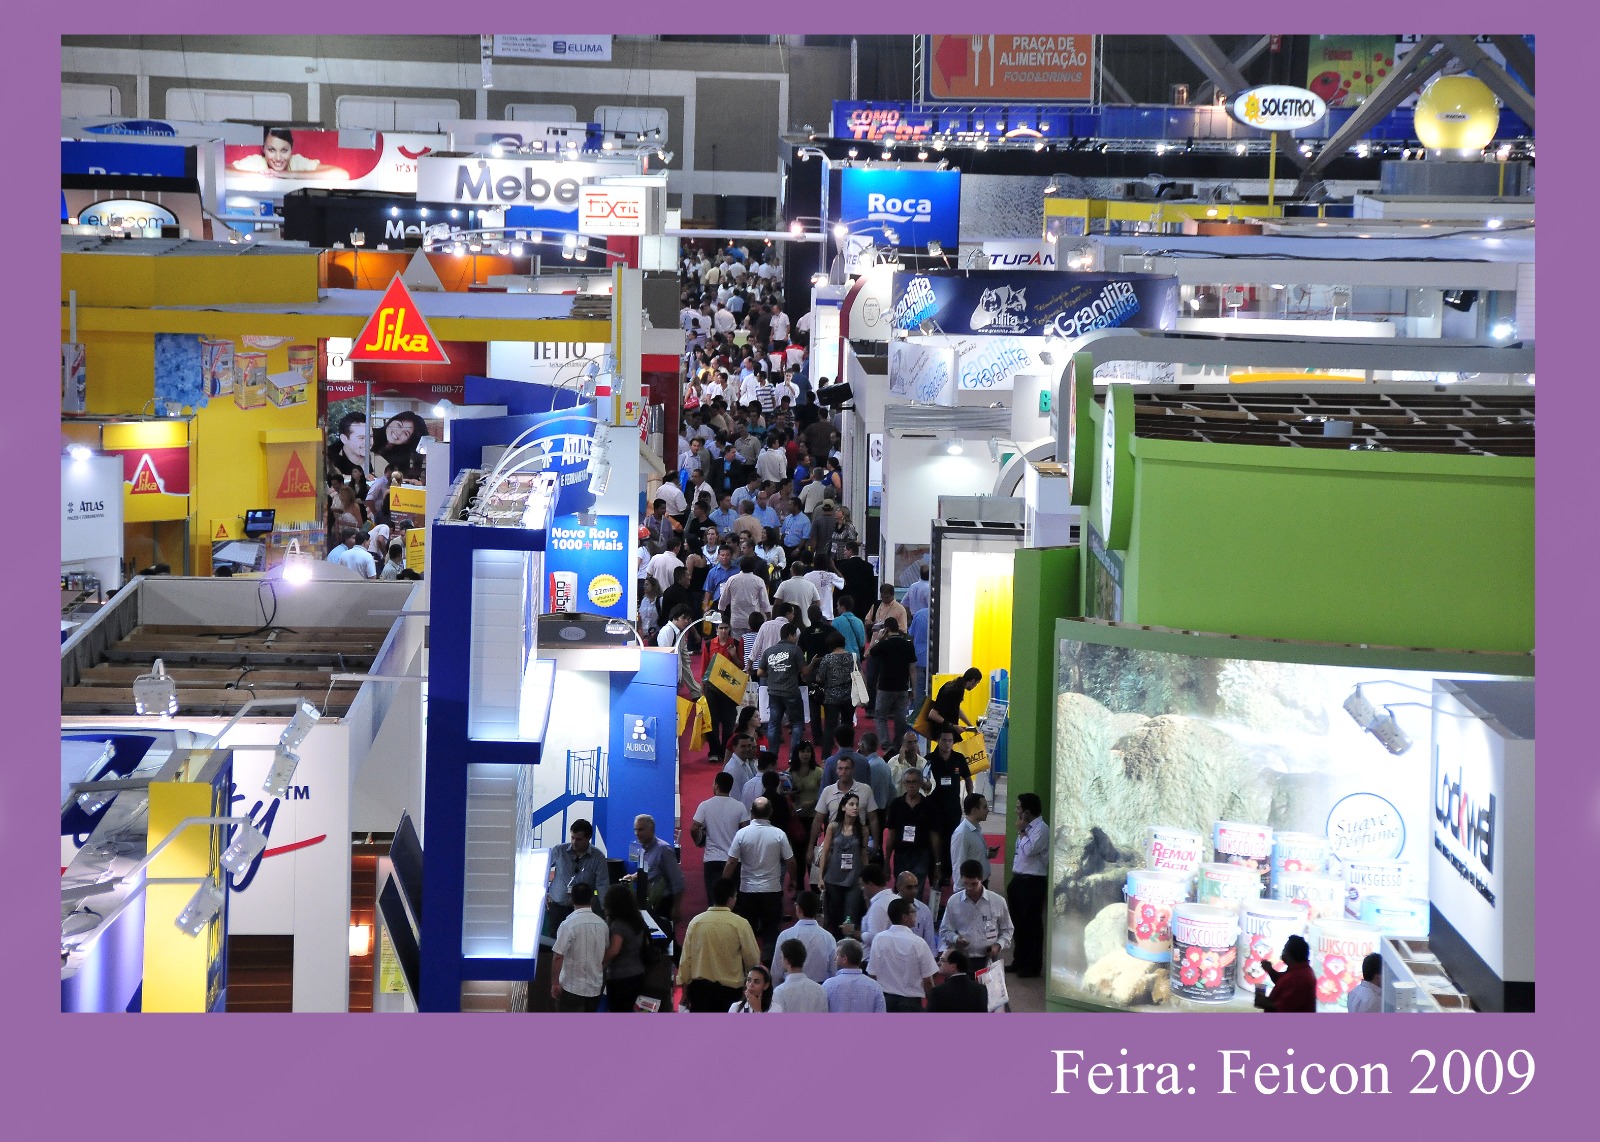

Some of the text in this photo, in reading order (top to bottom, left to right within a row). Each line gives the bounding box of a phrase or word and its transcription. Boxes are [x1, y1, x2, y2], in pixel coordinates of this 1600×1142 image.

[567, 43, 604, 53] ELUMA
[1012, 36, 1075, 54] PRAÇA DE
[1000, 49, 1087, 69] ALIMENTAÇÃO
[1003, 71, 1083, 83] FOOD&DRINKS
[851, 109, 900, 125] COMO
[1261, 98, 1317, 117] SOLETROL
[867, 193, 932, 213] Roca
[1053, 281, 1134, 338] Granilita
[365, 307, 429, 352] Sika
[135, 470, 158, 492] Sika
[282, 467, 311, 493] Sika
[79, 500, 104, 512] ATLAS
[551, 527, 618, 539] Novo Rolo
[625, 742, 654, 753] AUBICON
[1336, 814, 1388, 833] Suave
[1152, 841, 1197, 862] REMOV
[1349, 871, 1402, 887] LUKSGESSO
[1176, 924, 1229, 947] LUKSCOLOR
[1245, 916, 1273, 936] LUKS
[1318, 936, 1374, 957] LUKSCOLOR
